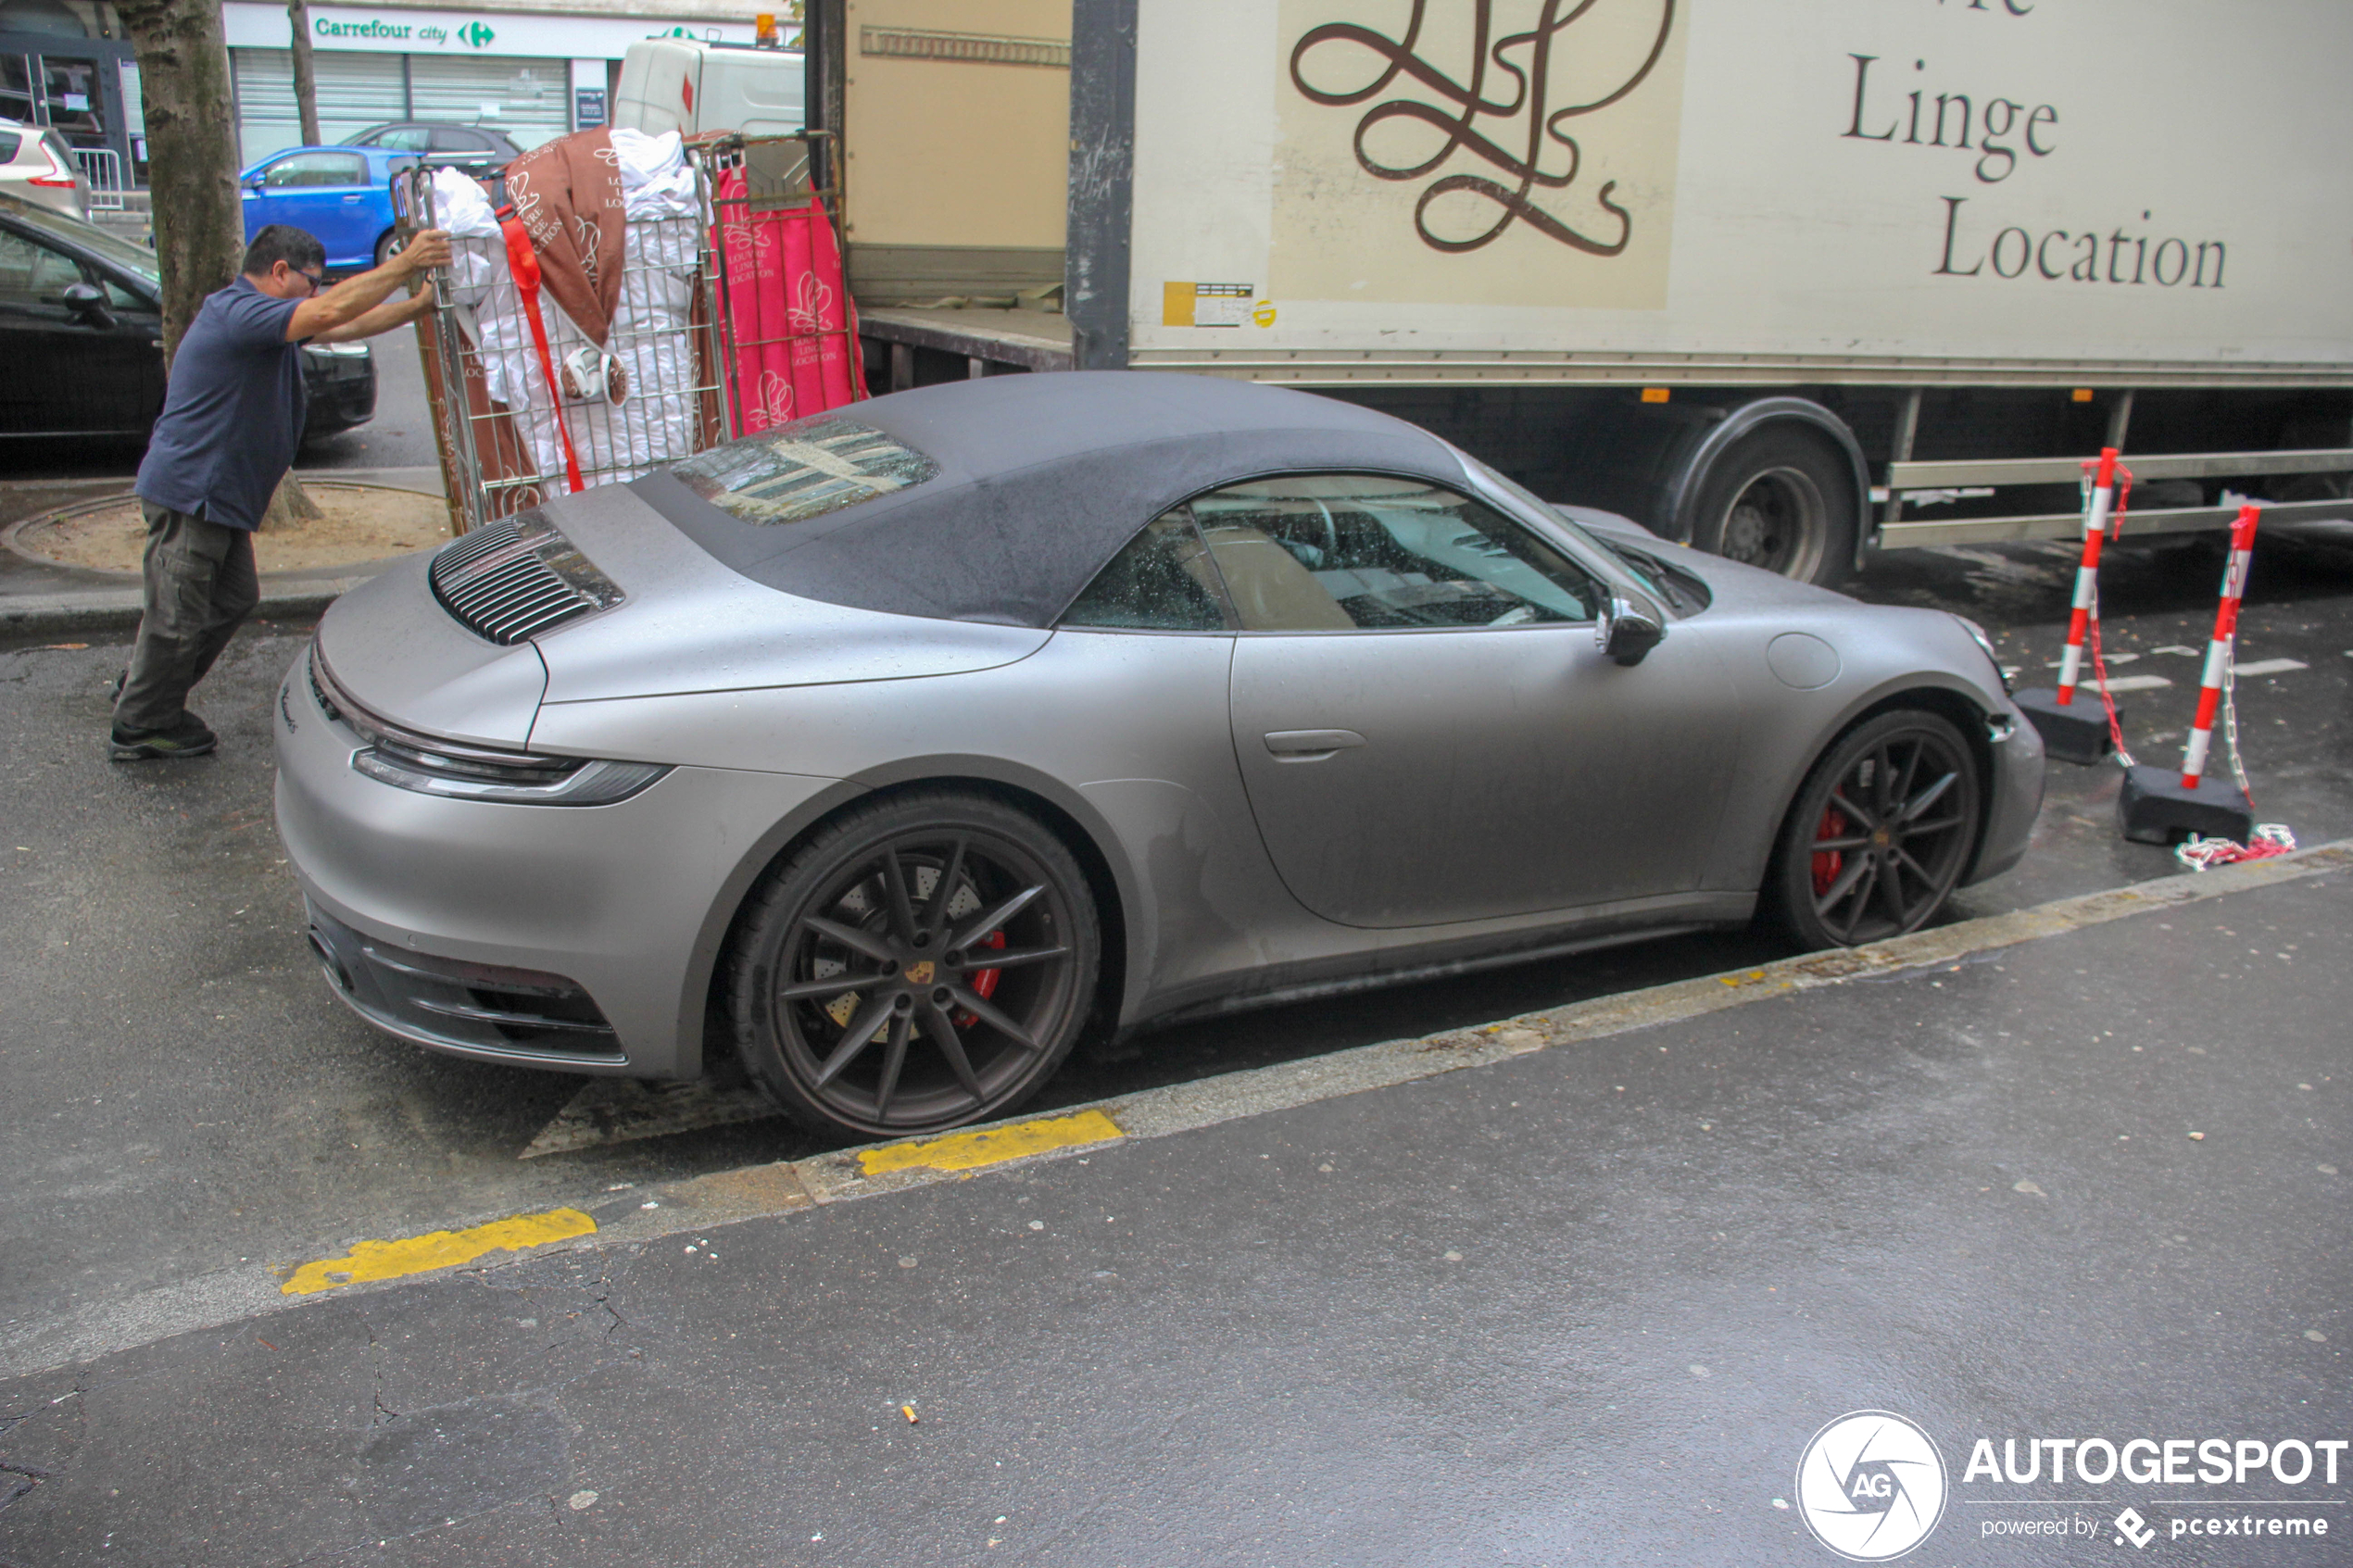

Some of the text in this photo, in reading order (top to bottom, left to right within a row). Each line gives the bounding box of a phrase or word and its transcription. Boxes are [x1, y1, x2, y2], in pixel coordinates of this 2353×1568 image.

[315, 18, 447, 45] Carrefour city
[1840, 52, 2059, 184] Linge
[1931, 194, 2227, 289] Location
[727, 269, 774, 286] LOCATON
[791, 352, 837, 367] LOCATON
